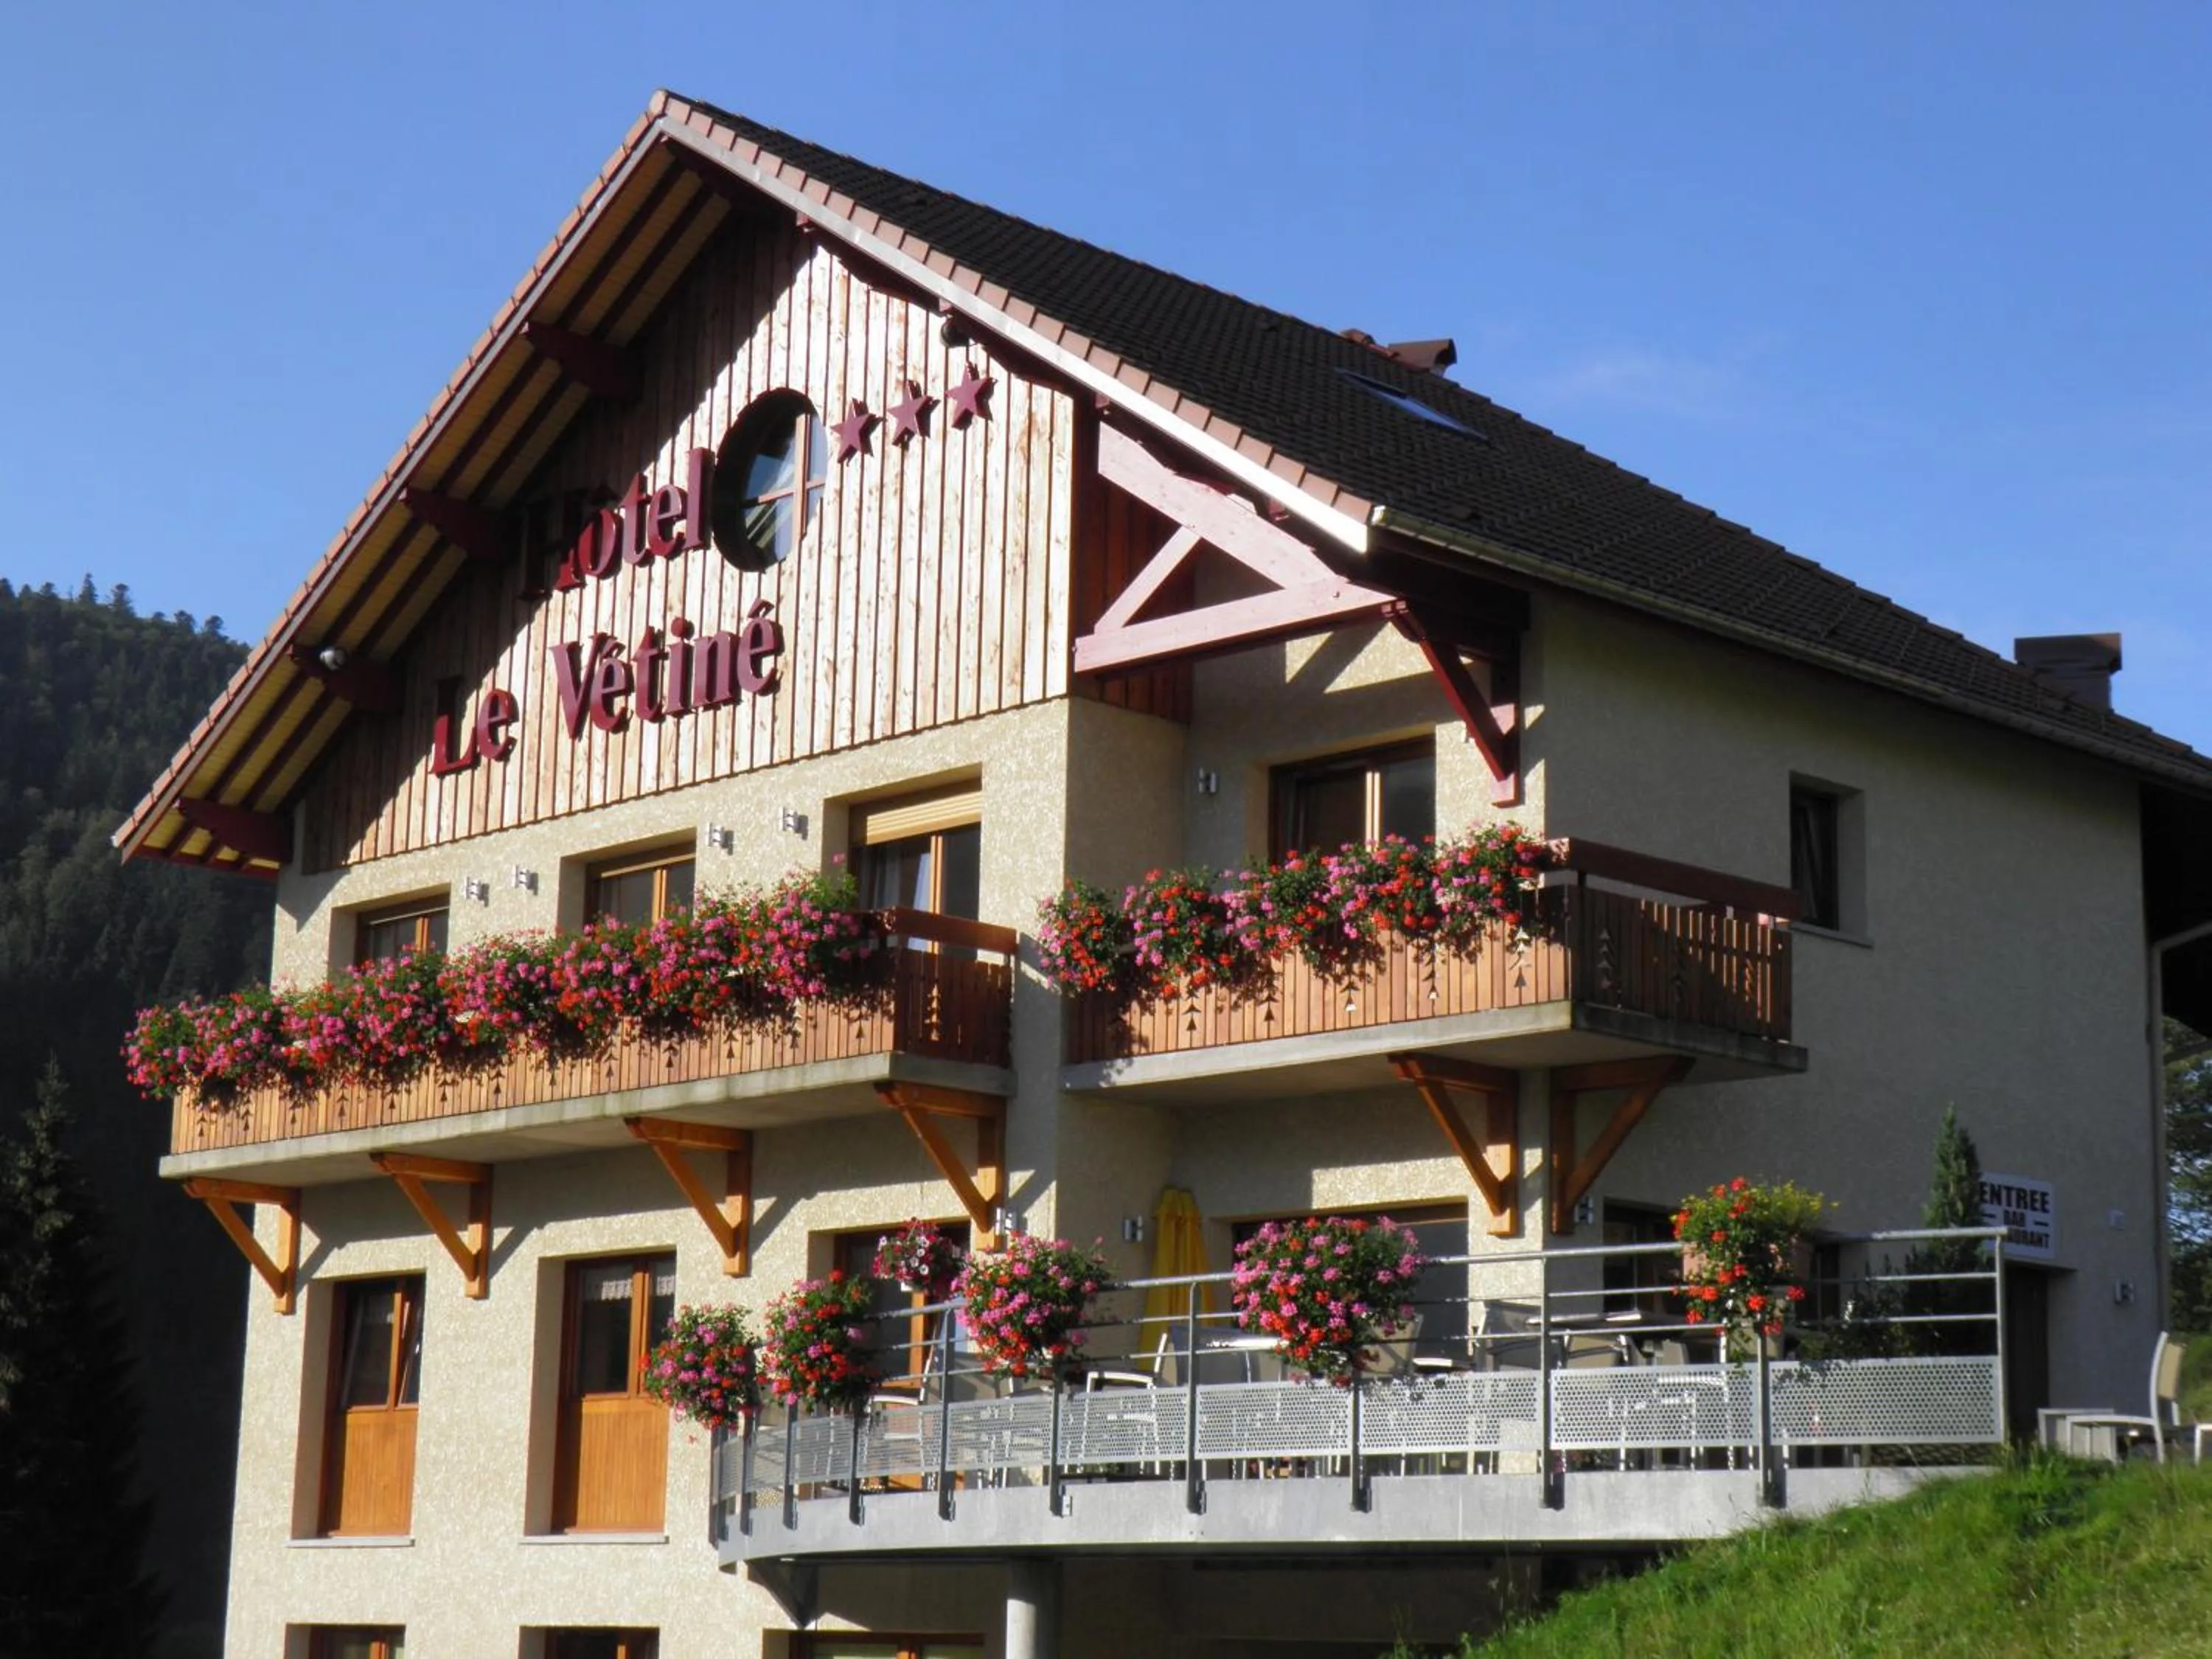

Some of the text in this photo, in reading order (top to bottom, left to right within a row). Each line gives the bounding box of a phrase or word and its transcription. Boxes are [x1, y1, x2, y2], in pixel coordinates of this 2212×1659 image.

[430, 599, 782, 776] Le Vétiné
[1979, 1182, 2050, 1214] ENTREE
